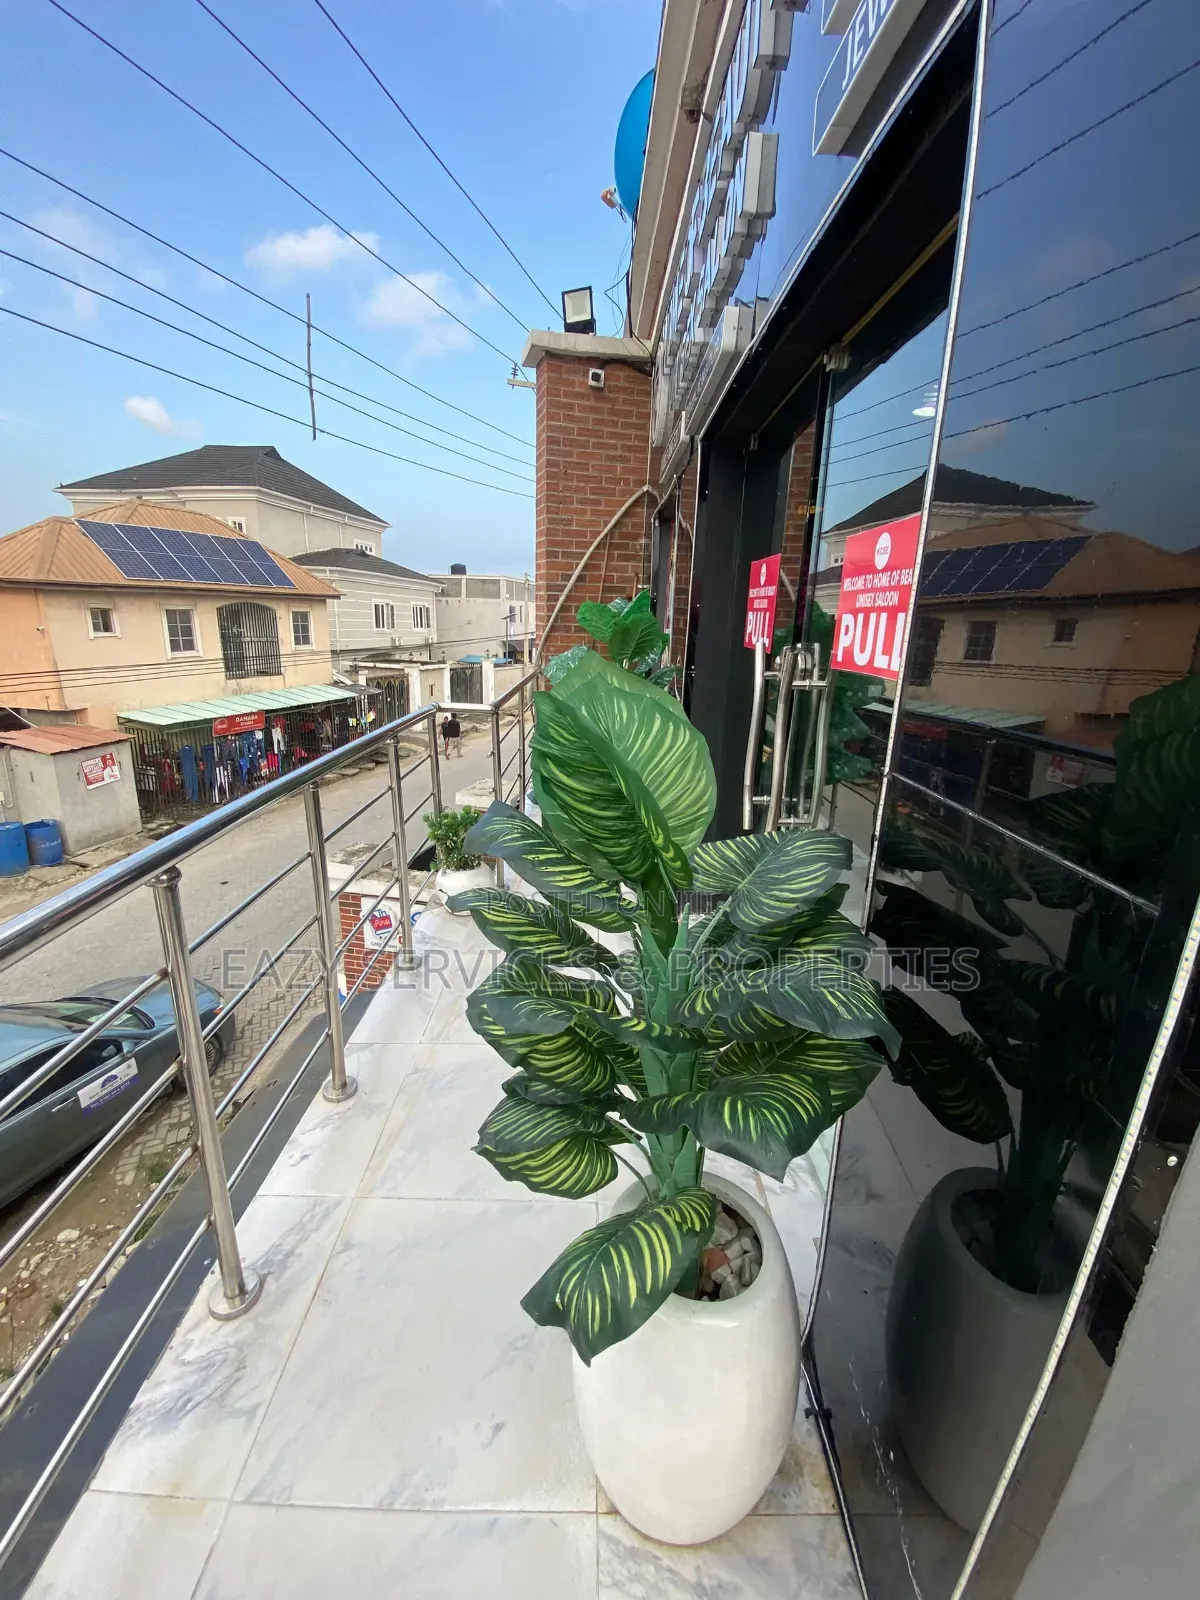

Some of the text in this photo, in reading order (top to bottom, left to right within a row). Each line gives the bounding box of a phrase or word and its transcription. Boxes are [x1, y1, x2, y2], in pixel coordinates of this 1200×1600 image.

[844, 575, 866, 591] WELCOME
[866, 574, 873, 588] TO
[873, 571, 891, 588] HOME
[891, 570, 900, 586] OF
[856, 591, 899, 608] UNISEX SALOON
[746, 611, 770, 647] PULL
